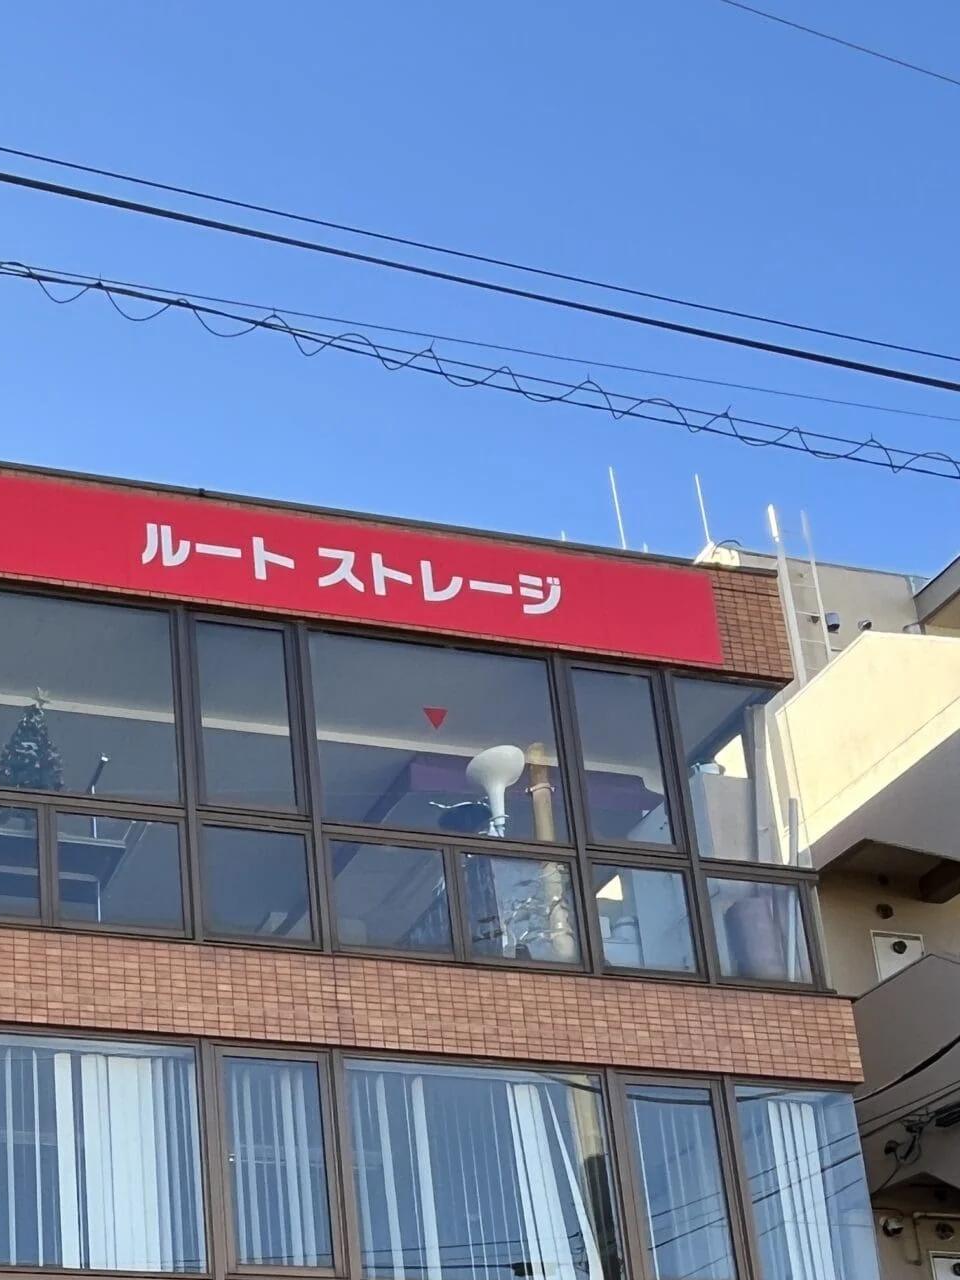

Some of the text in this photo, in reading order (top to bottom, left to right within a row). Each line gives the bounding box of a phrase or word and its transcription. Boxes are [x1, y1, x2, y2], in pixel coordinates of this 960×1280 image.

[141, 523, 562, 615] ルート ストレージ
